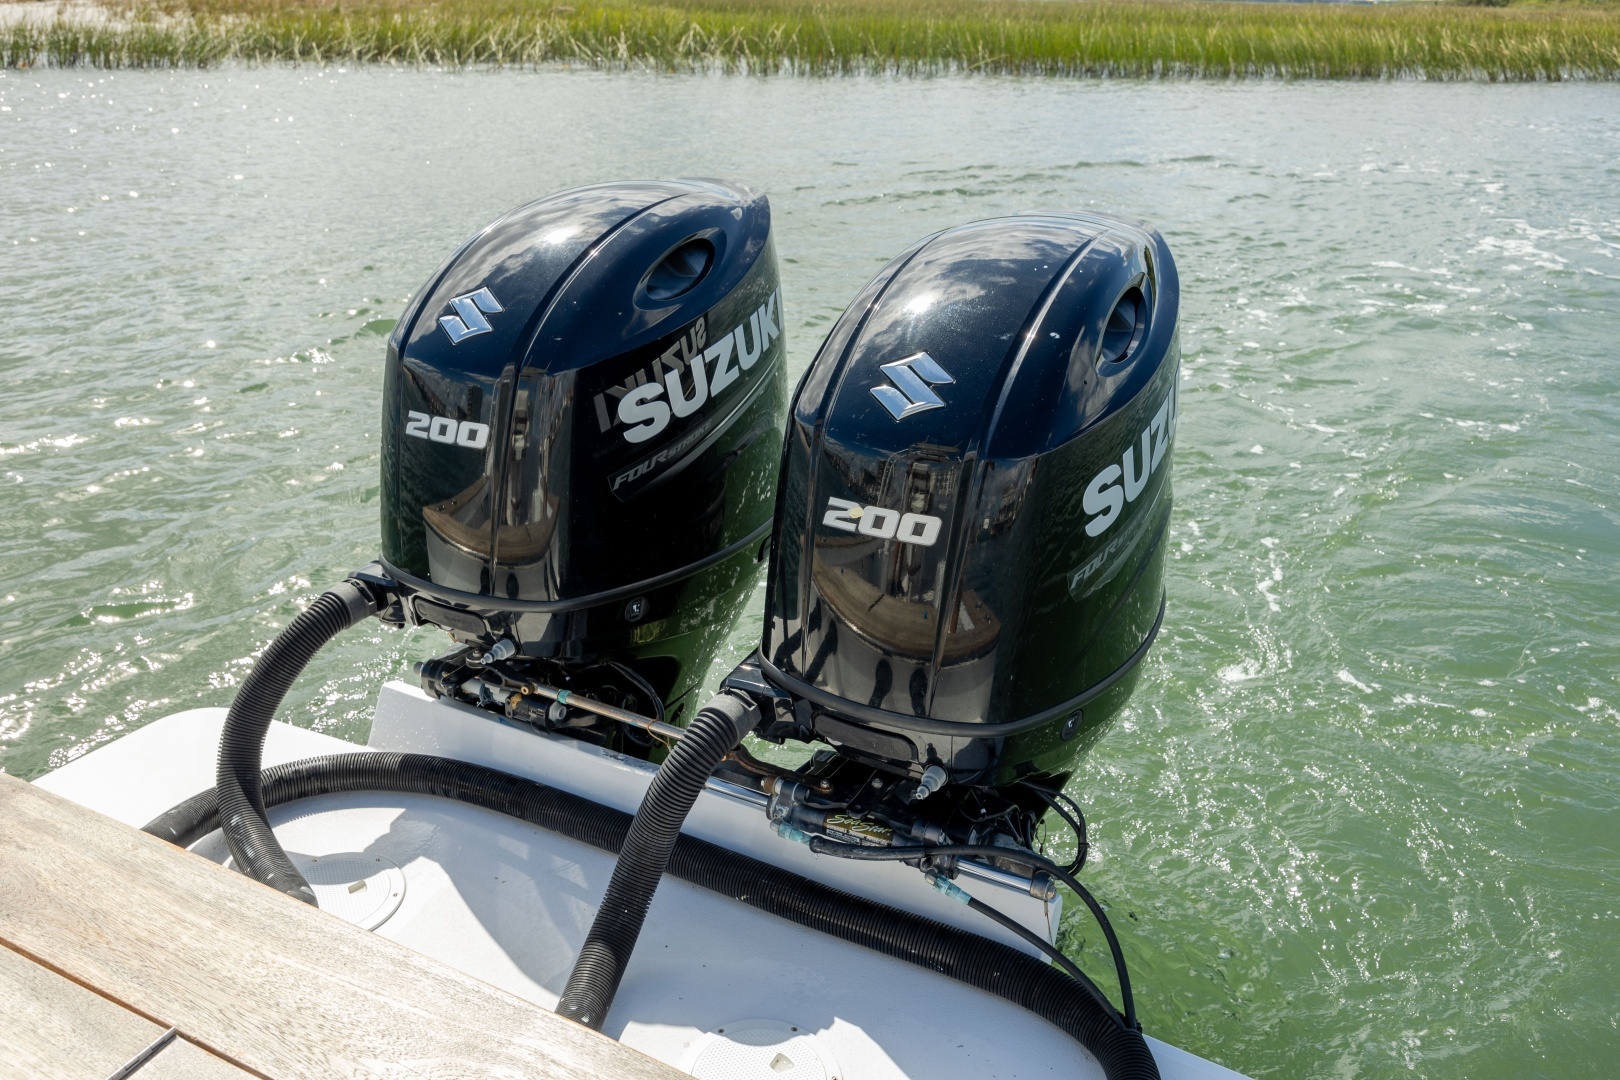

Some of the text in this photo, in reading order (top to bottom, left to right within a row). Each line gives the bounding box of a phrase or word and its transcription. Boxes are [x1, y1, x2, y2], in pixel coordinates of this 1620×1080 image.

[618, 284, 784, 444] SUZUKI
[405, 409, 490, 450] 200
[822, 496, 943, 547] 200
